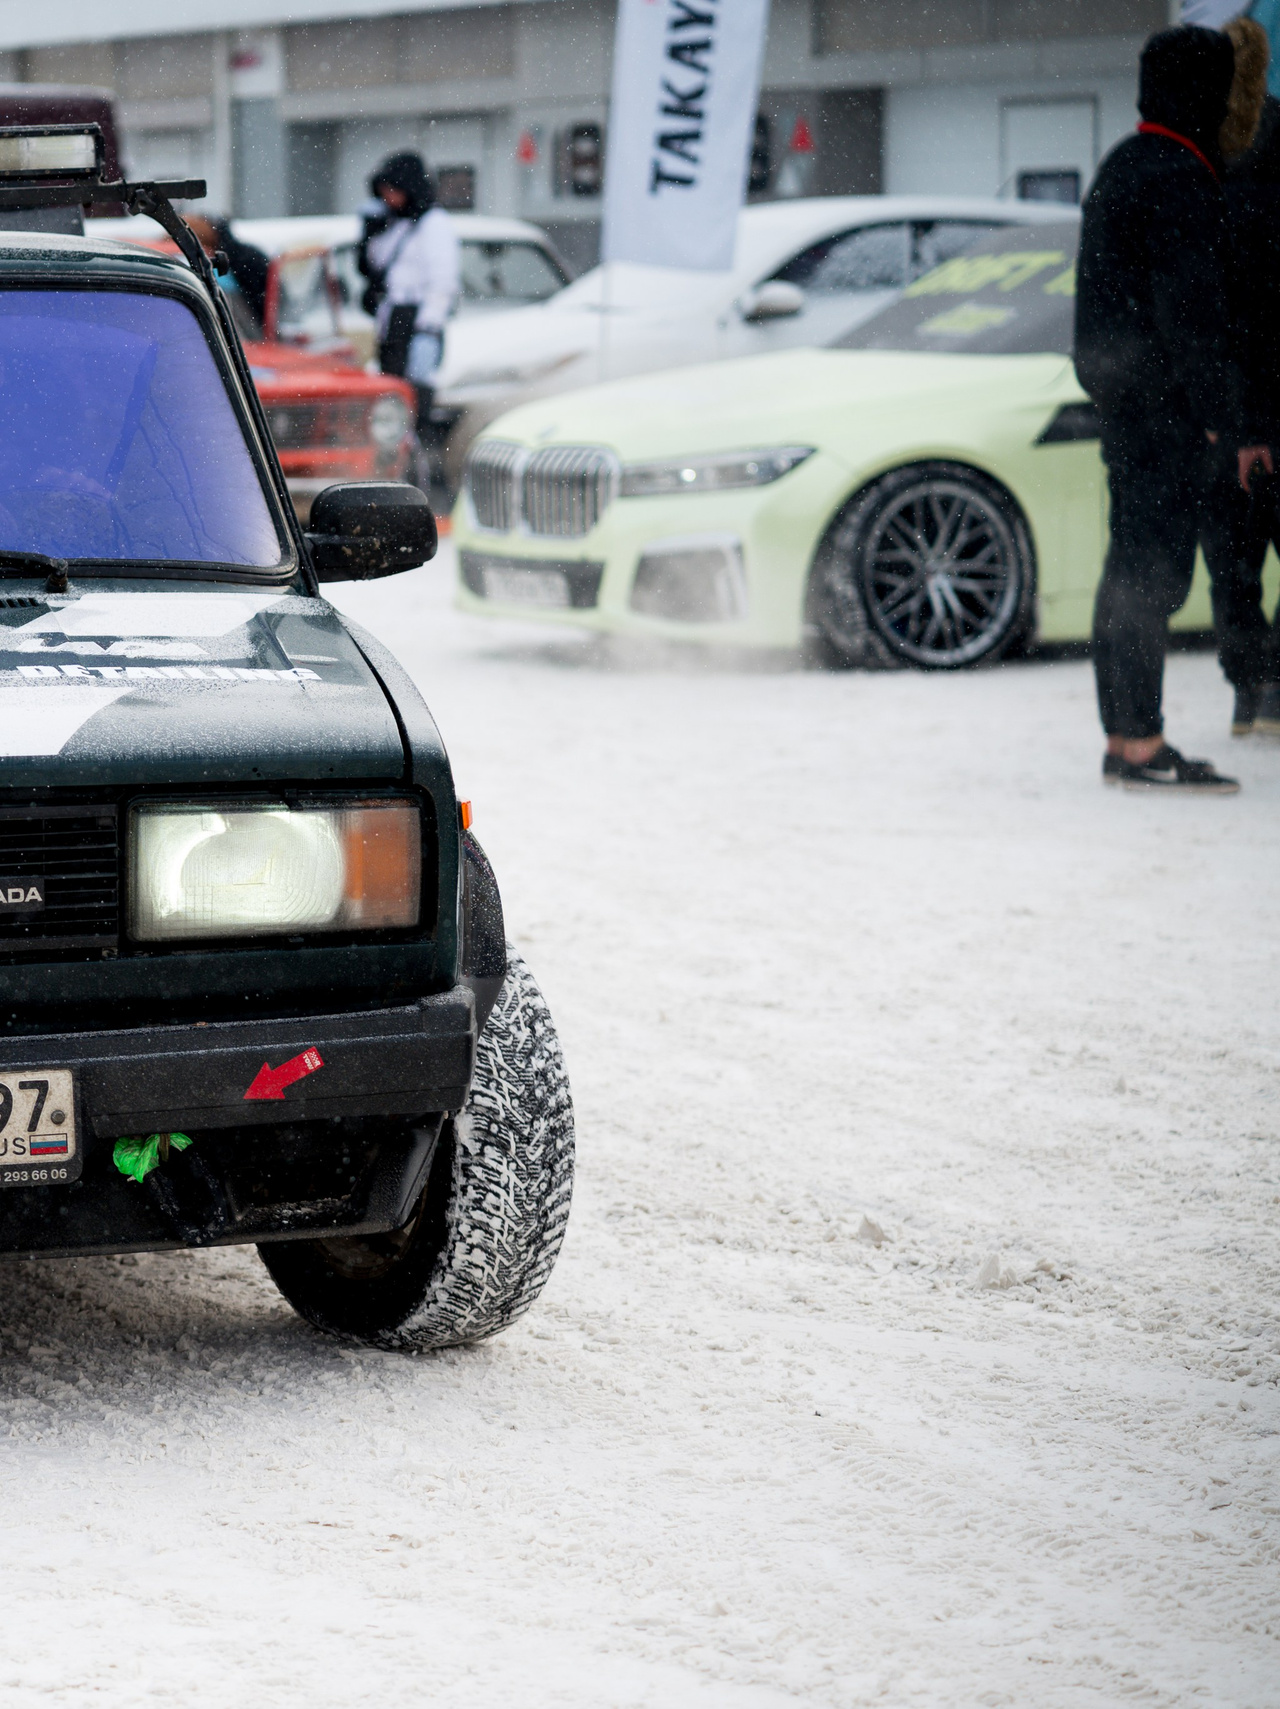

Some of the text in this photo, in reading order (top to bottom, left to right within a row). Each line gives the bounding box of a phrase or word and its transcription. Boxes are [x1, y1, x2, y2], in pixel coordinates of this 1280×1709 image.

[649, 0, 716, 195] TAKAY
[16, 665, 322, 681] DETAILING
[4, 1171, 28, 1182] 293
[31, 1169, 48, 1180] 66
[51, 1168, 67, 1179] 06
